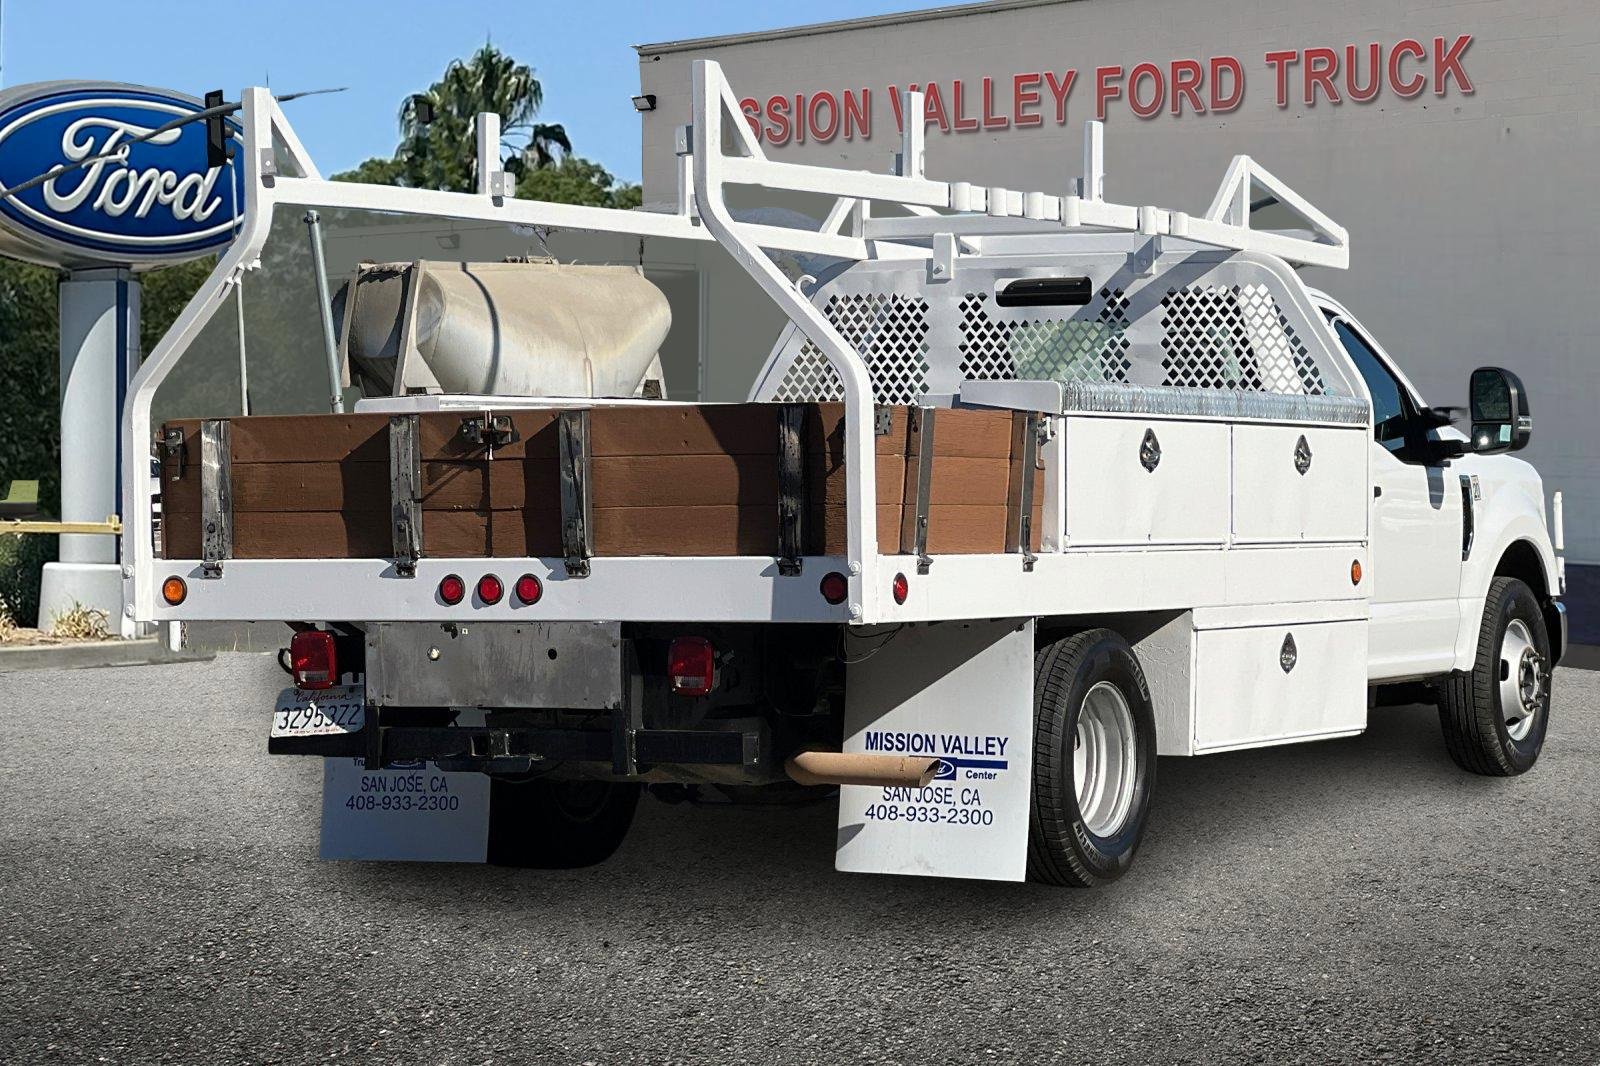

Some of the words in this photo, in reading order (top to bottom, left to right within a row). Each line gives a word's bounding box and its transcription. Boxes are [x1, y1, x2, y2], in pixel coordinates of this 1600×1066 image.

[739, 88, 870, 145] SSION
[1096, 55, 1244, 120] FORD
[1265, 35, 1473, 106] TRUCK
[43, 117, 222, 222] Ford
[293, 689, 352, 704] California
[865, 731, 936, 753] MISSION
[941, 734, 1009, 756] VALLEY
[353, 757, 366, 767] Tru
[965, 769, 997, 780] Center
[361, 776, 387, 793] SAN
[390, 776, 426, 794] JOSE,
[430, 776, 448, 793] CA
[346, 796, 459, 811] 408-933-2300
[883, 786, 911, 802] SAN
[915, 786, 956, 807] JOSE,
[961, 787, 981, 806] CA
[865, 804, 994, 826] 408-933-2300
